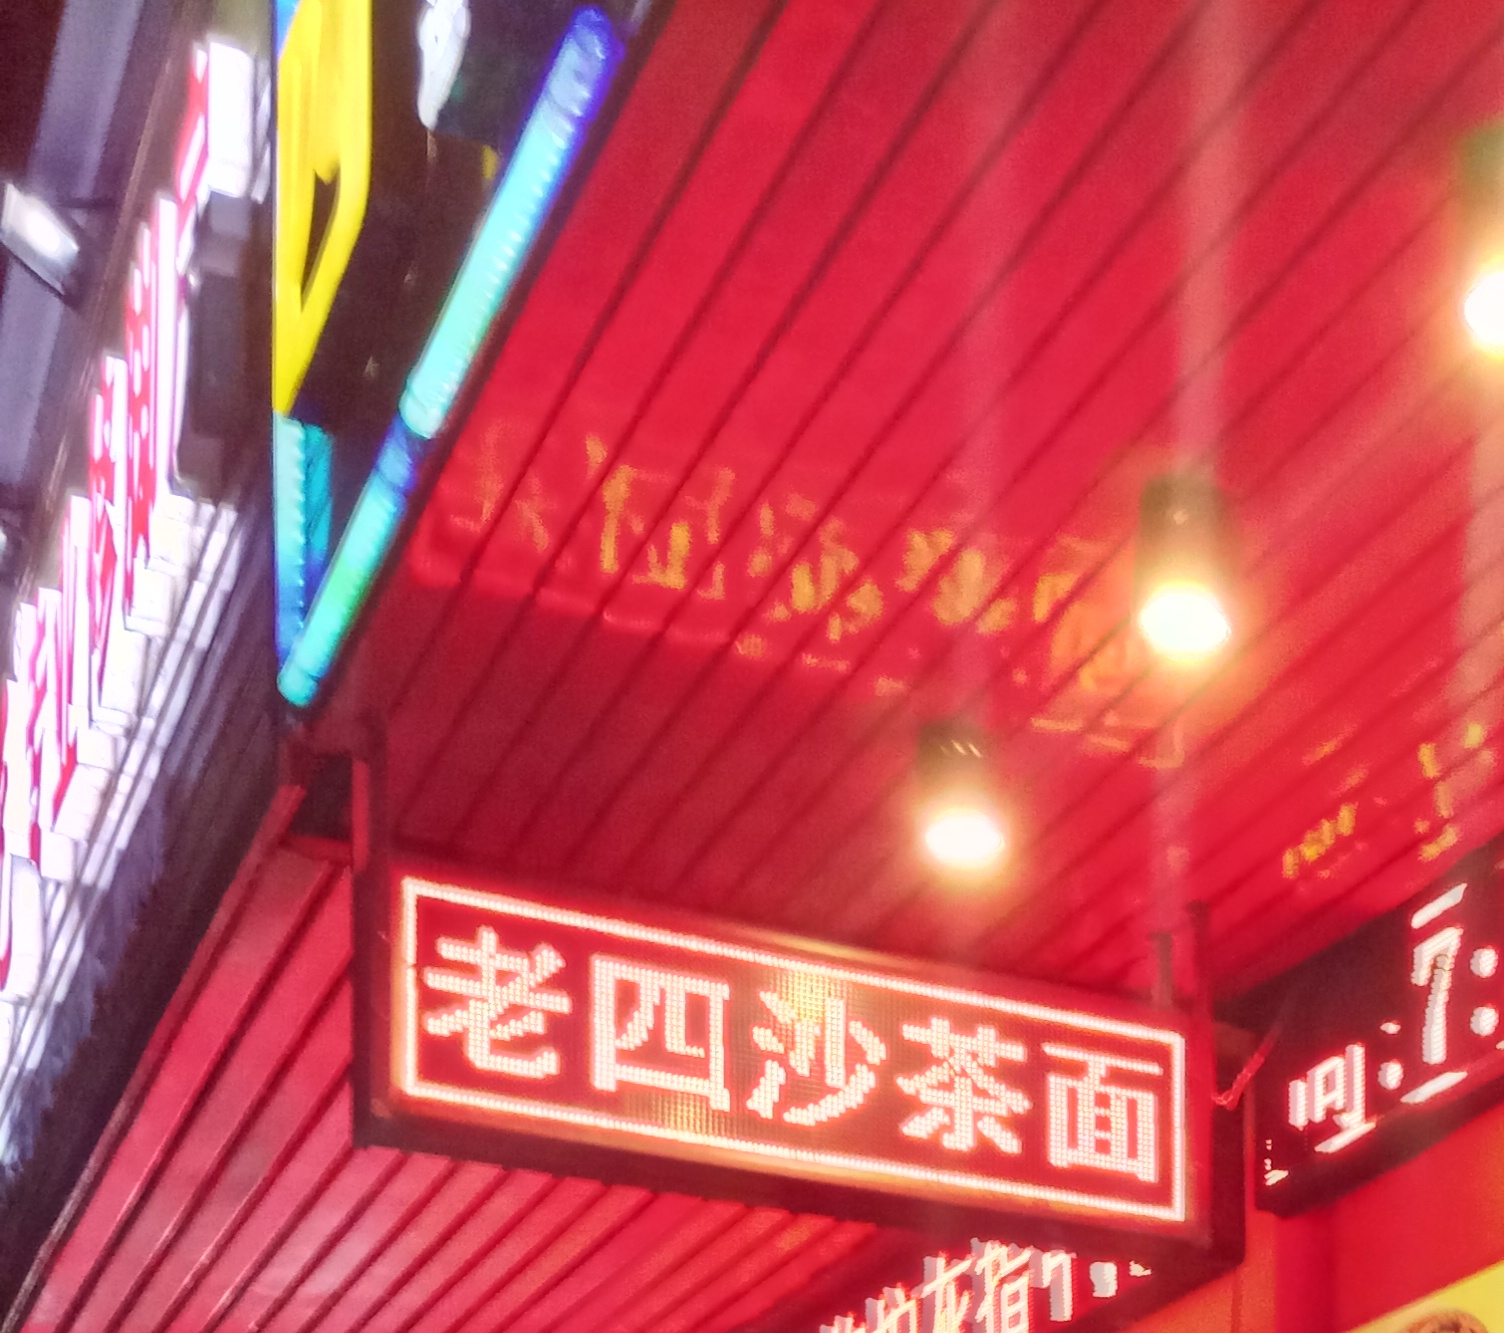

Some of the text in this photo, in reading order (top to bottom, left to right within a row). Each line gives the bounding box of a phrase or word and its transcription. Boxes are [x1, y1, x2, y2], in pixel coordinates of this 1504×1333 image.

[422, 924, 1164, 1183] 老四沙茶面
